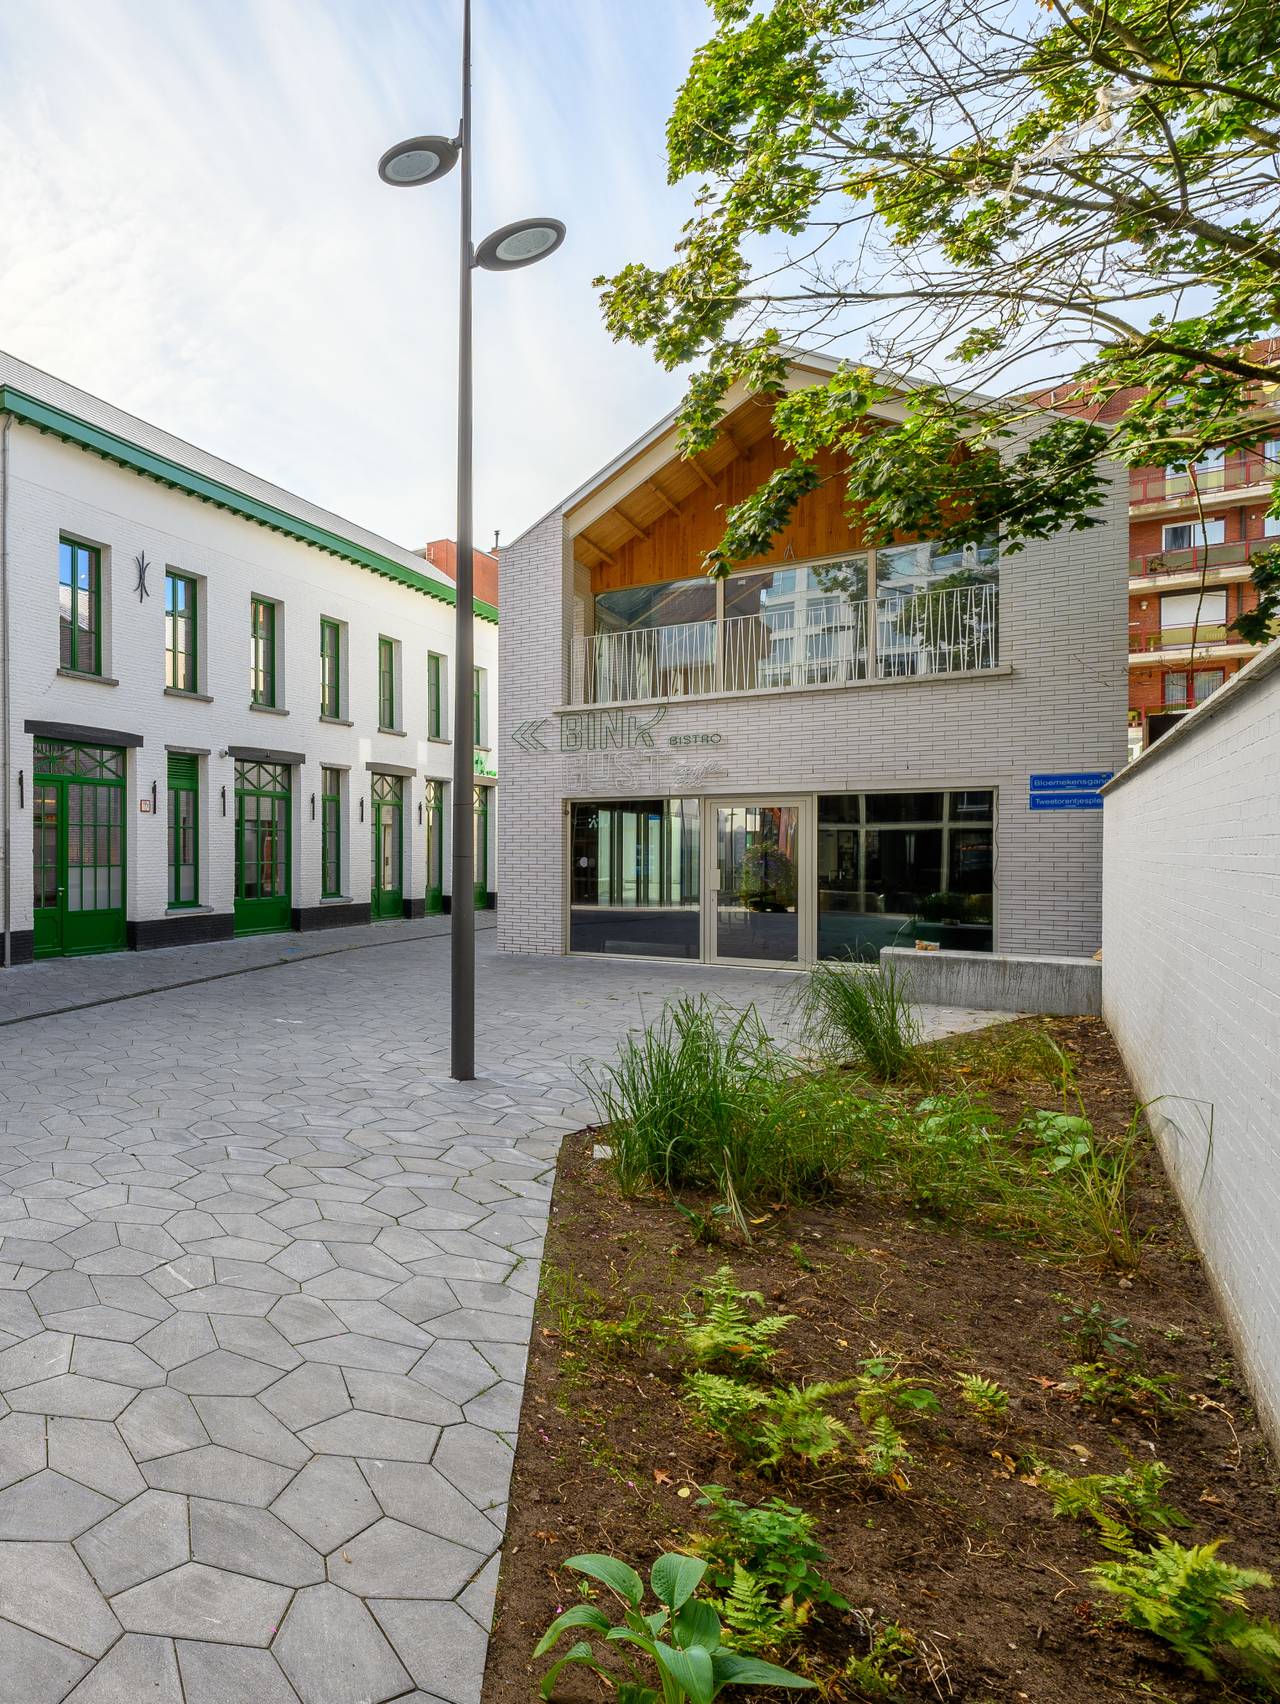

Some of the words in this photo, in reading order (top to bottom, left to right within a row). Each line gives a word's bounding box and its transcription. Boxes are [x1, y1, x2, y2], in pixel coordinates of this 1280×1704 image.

[560, 705, 668, 752] BINK
[669, 733, 722, 746] BISTRO
[1035, 798, 1102, 807] Tweetorentjesple
